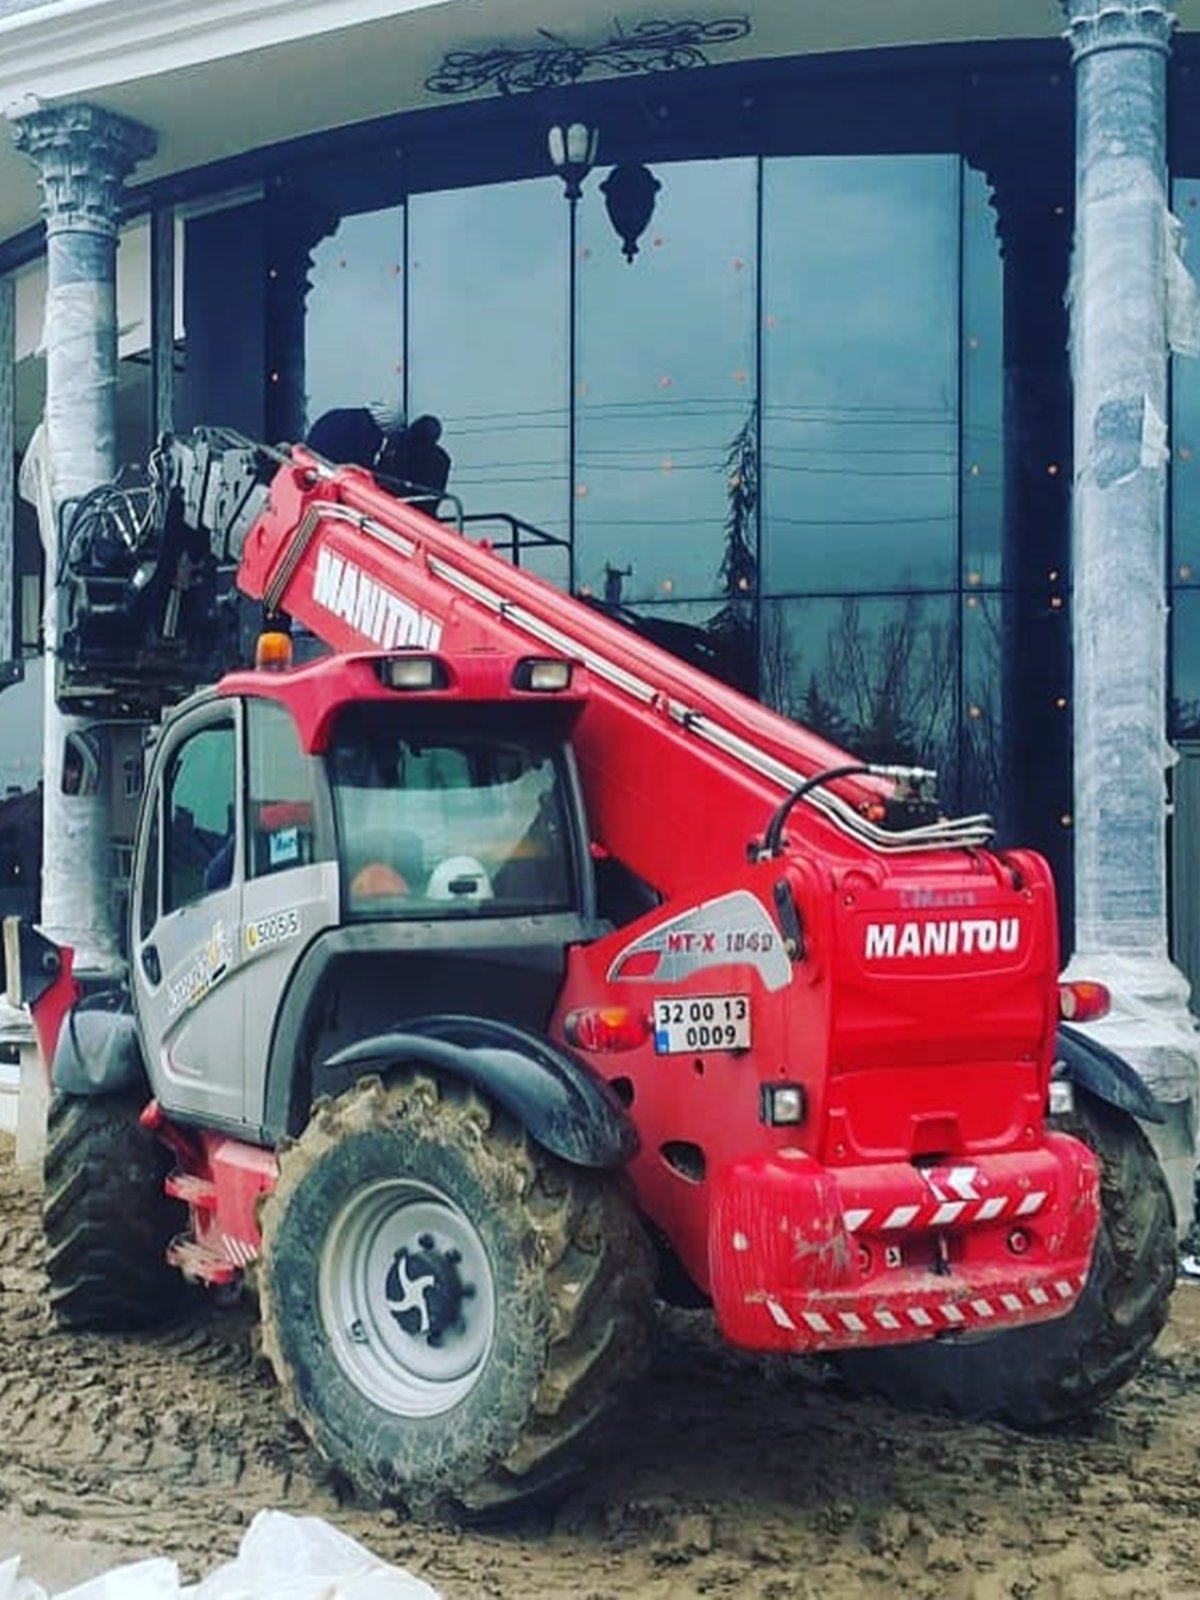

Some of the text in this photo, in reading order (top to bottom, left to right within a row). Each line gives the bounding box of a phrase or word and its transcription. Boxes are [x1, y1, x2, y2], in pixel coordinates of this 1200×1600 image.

[312, 542, 444, 651] MANITOU
[667, 933, 715, 952] MT-X
[865, 917, 1019, 960] MANITOU
[659, 1000, 746, 1024] 32 00 13
[686, 1025, 736, 1046] 0009
